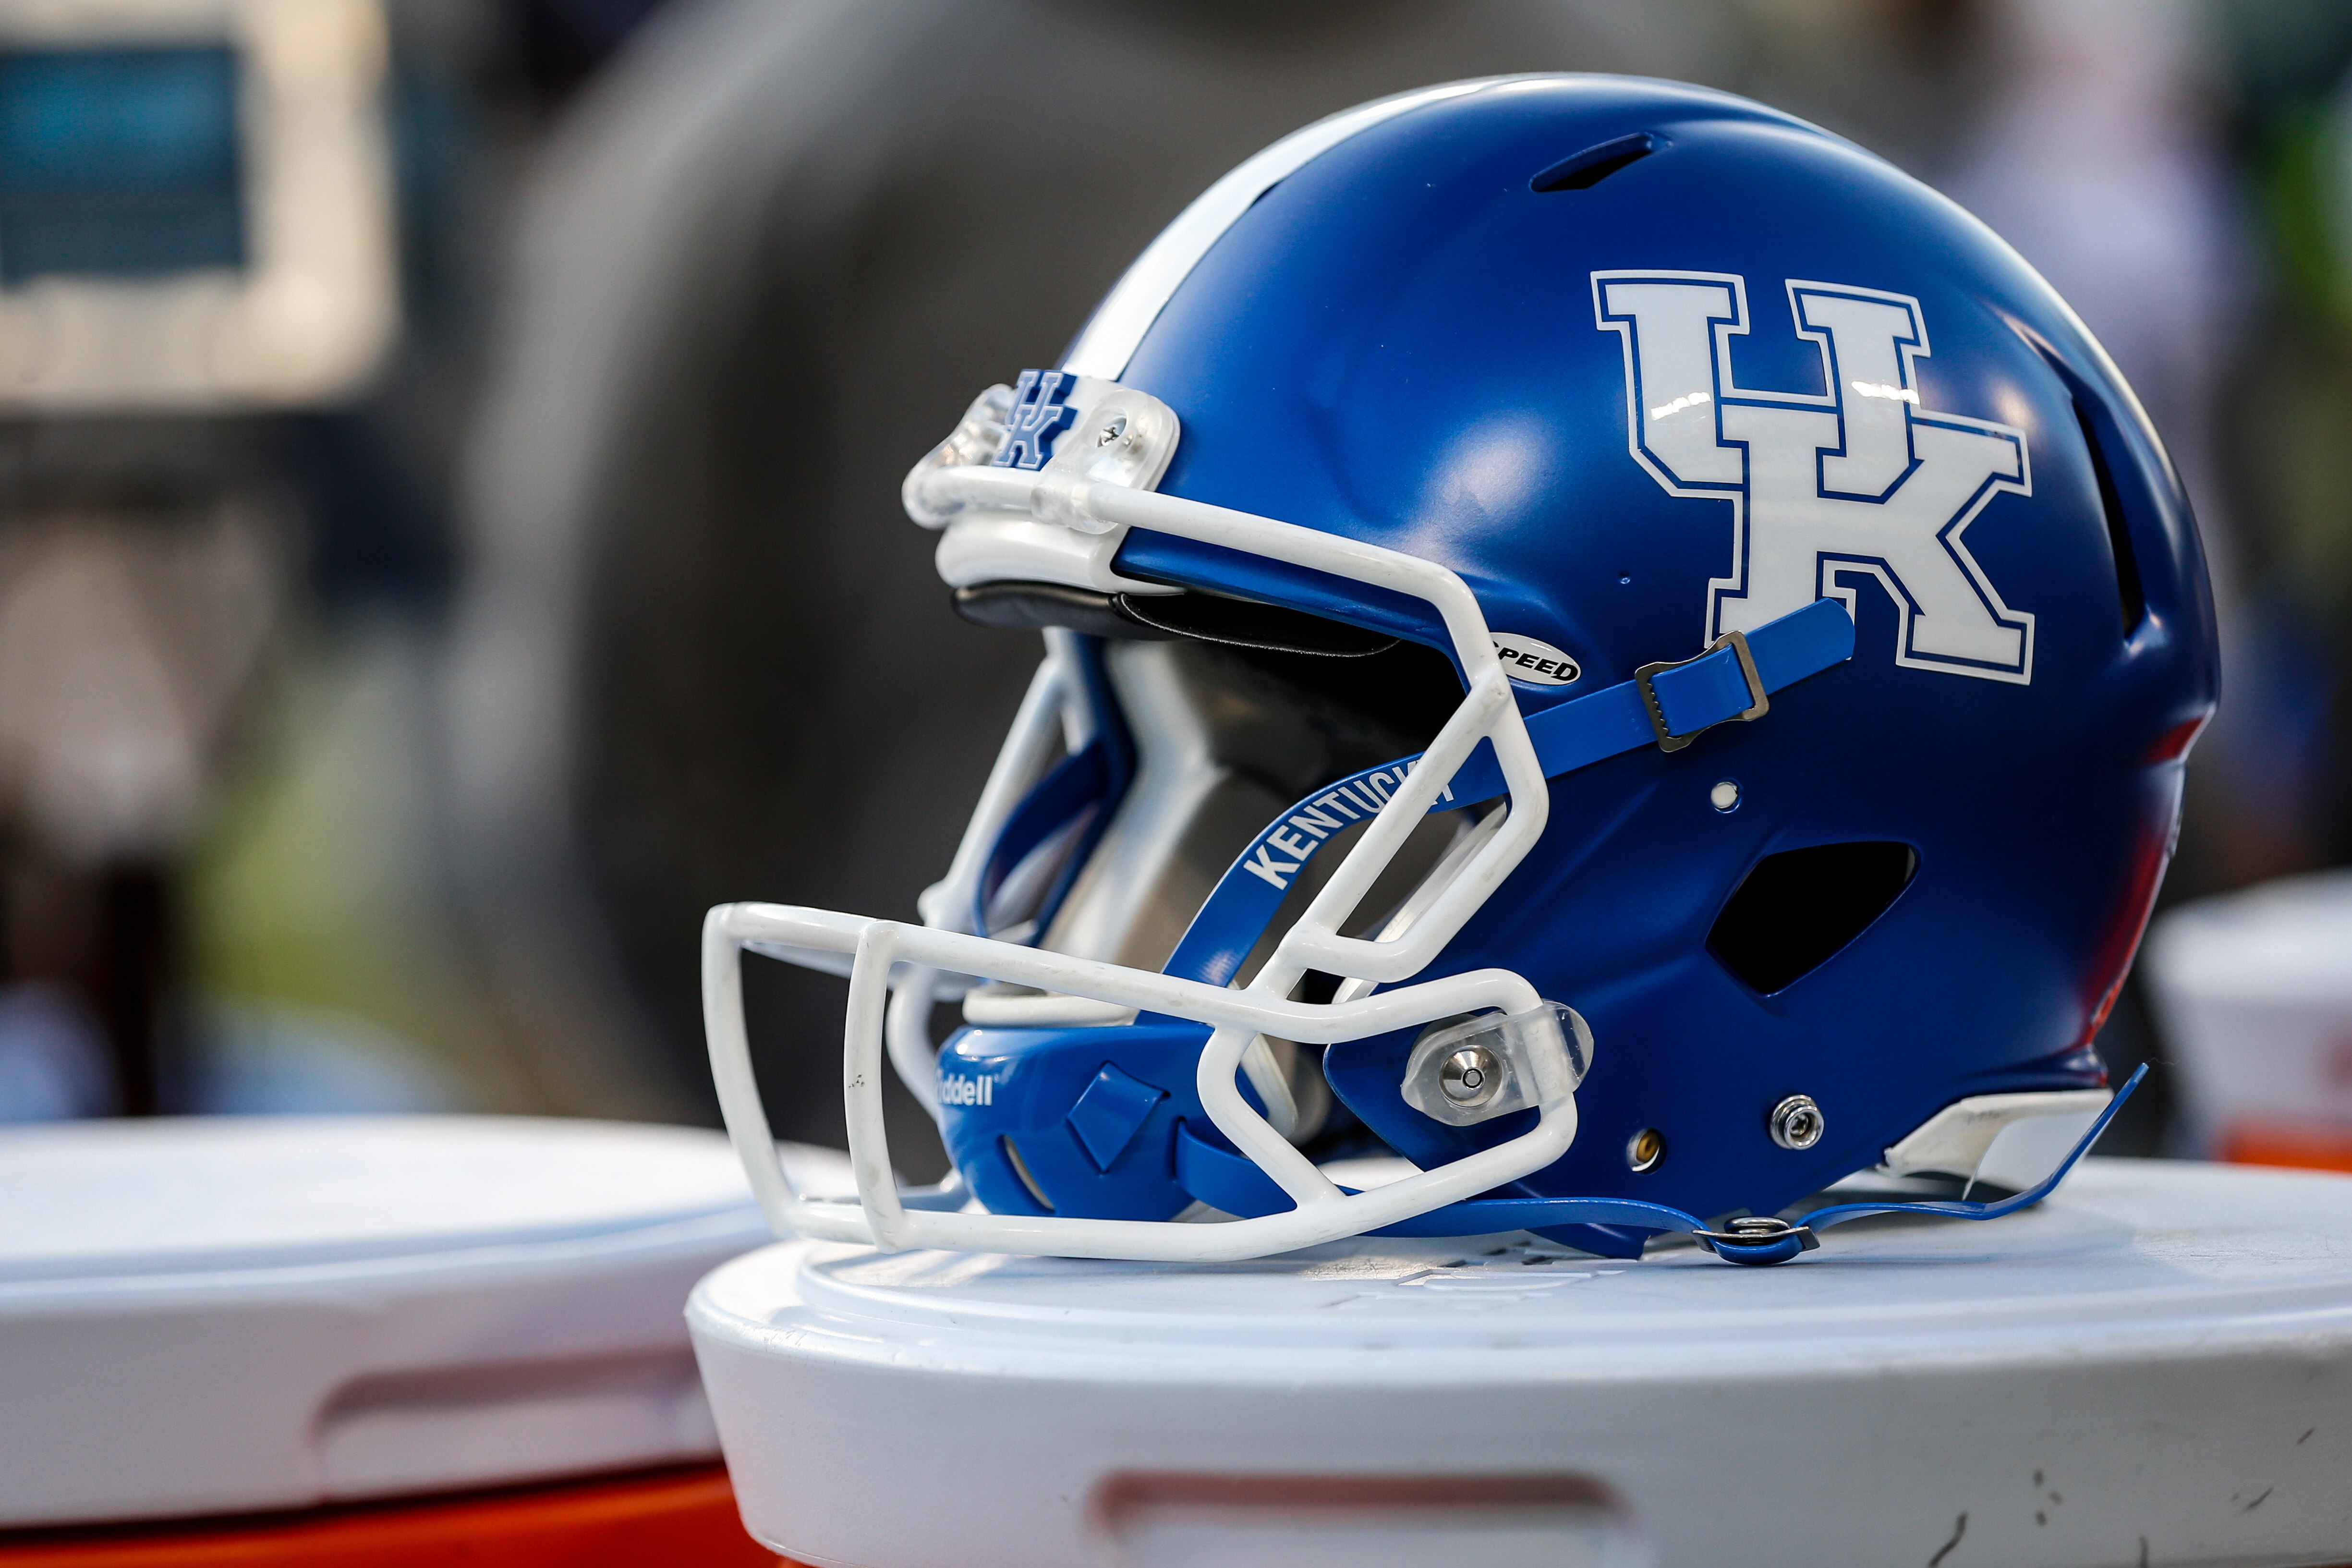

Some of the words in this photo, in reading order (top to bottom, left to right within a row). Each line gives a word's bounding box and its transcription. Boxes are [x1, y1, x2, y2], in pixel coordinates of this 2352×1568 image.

[992, 368, 1070, 470] UK
[1590, 269, 2035, 686] UK
[1493, 641, 1578, 681] PEED
[936, 1068, 993, 1106] iddell
